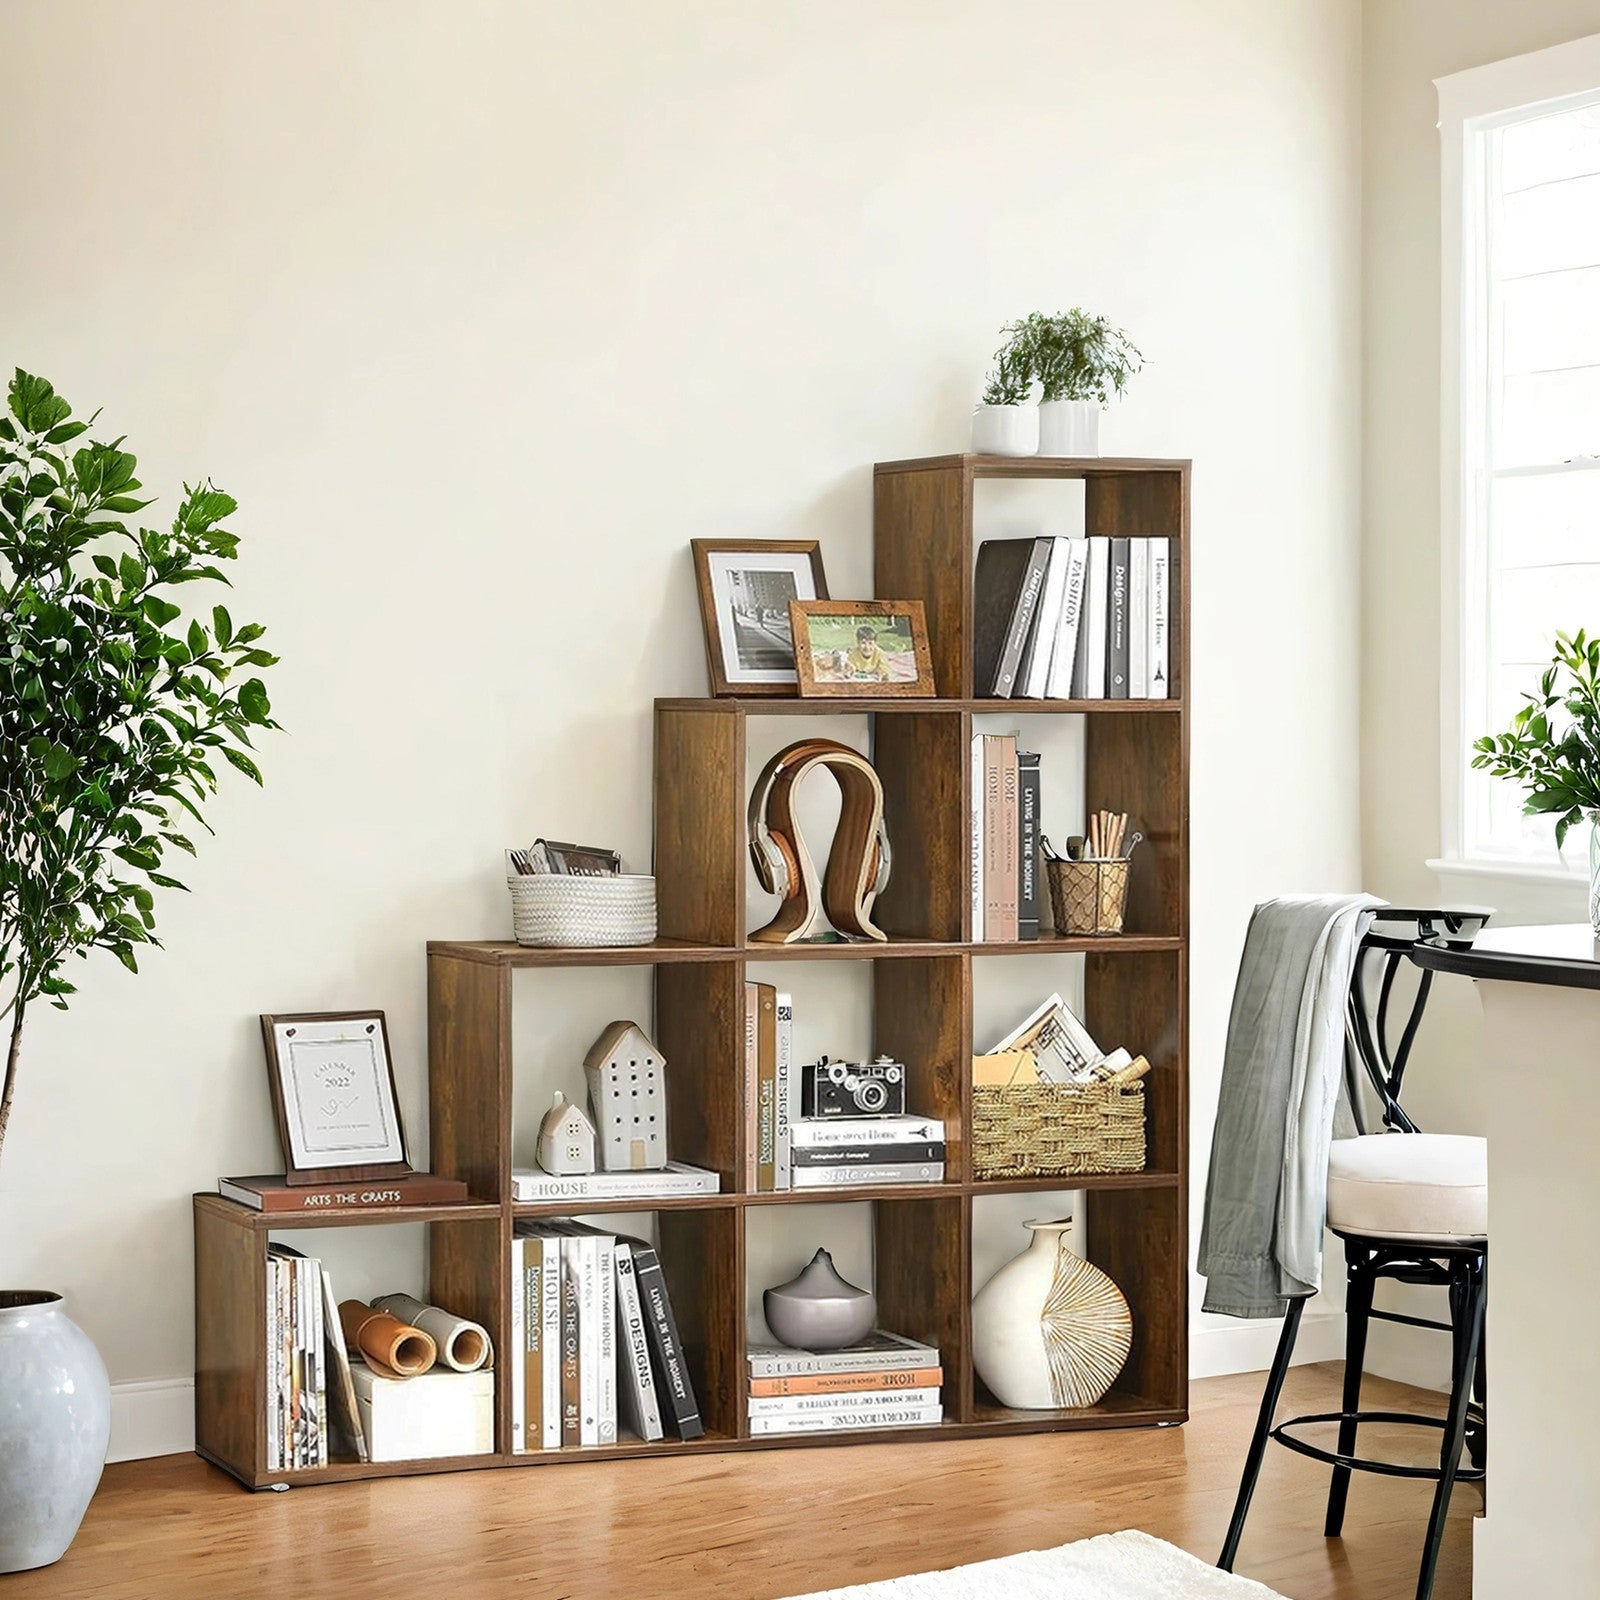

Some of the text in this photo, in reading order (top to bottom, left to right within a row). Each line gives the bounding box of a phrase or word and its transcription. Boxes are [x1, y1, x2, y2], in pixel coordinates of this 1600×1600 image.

[1066, 560, 1082, 627] FASHION
[1113, 565, 1125, 605] Design
[989, 766, 998, 803] HOME
[1004, 767, 1015, 804] HOME
[1024, 787, 1034, 901] LIVING IN THE MOMENT
[778, 1064, 788, 1137] DESIGNS
[304, 1191, 401, 1206] ARTS THE CRAFTS
[539, 1182, 588, 1196] HOUSE
[601, 1252, 610, 1274] THE
[531, 1267, 541, 1325] Decoration
[545, 1269, 558, 1331] HOUSE
[564, 1280, 577, 1379] ARTS THE CRAFTS
[602, 1322, 611, 1359] HOUSE
[649, 1287, 686, 1399] LIVING IN THE MOMENT
[630, 1318, 651, 1389] DESIGNS
[766, 1361, 822, 1374] CEREAL
[881, 1373, 916, 1386] HOME
